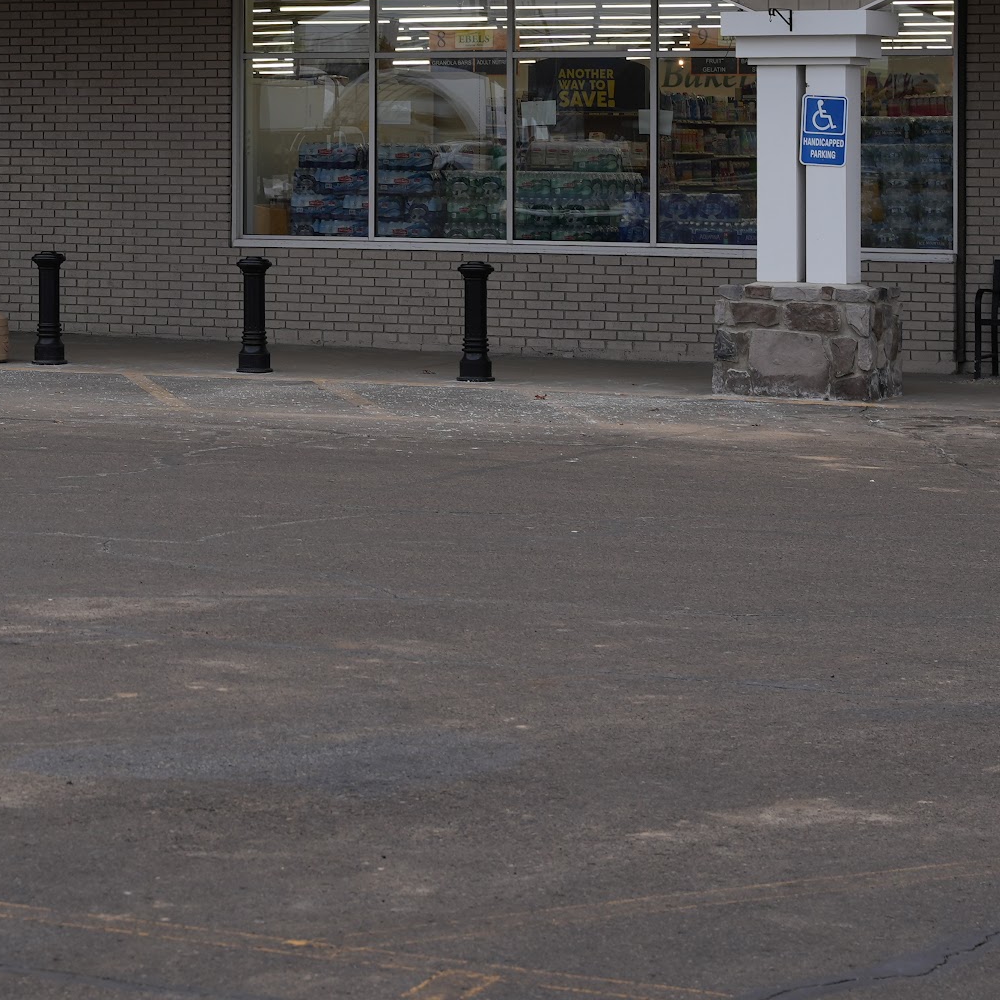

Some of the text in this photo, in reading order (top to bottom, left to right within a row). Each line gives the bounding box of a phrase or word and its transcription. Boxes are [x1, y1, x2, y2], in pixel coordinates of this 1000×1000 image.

[437, 31, 446, 48] 8
[458, 34, 490, 44] EBELS
[698, 28, 708, 46] 9
[558, 68, 615, 79] ANOTHER
[558, 79, 606, 90] WAY TO
[558, 80, 616, 107] SAVE!
[803, 137, 844, 148] HANDICAPPED
[810, 149, 836, 159] PARKING
